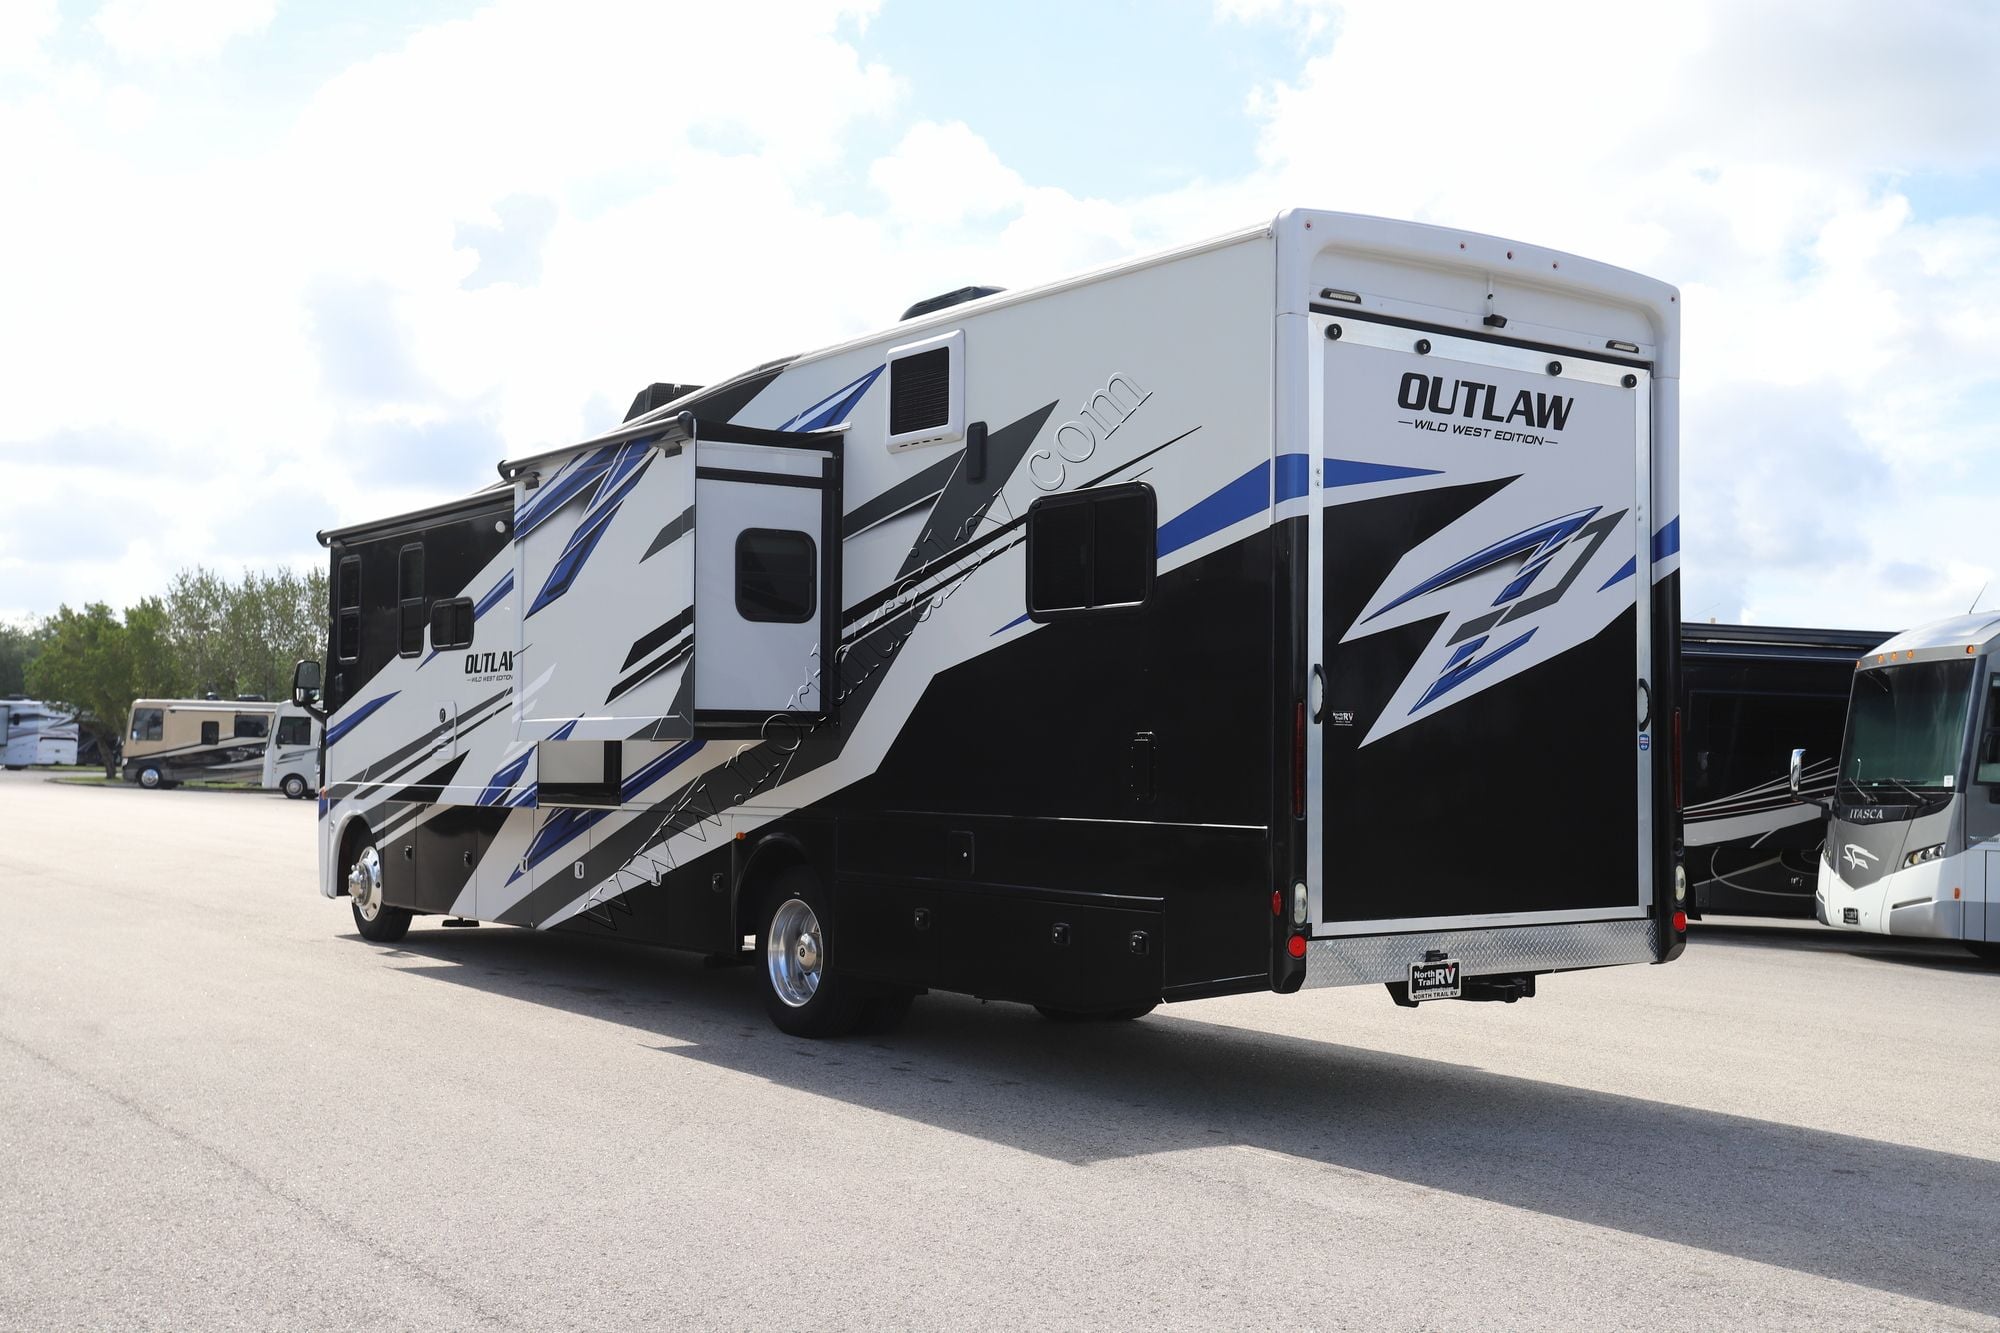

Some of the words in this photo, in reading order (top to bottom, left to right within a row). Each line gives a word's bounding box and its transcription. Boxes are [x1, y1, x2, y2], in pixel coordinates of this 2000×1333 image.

[1397, 371, 1575, 431] OUTLAW
[1414, 418, 1448, 433] WILD
[1452, 423, 1491, 438] WEST
[1494, 430, 1544, 446] EDITION
[1849, 808, 1883, 819] ITASCA
[1414, 970, 1435, 978] North
[1436, 968, 1456, 984] RV
[1418, 978, 1435, 986] Trail
